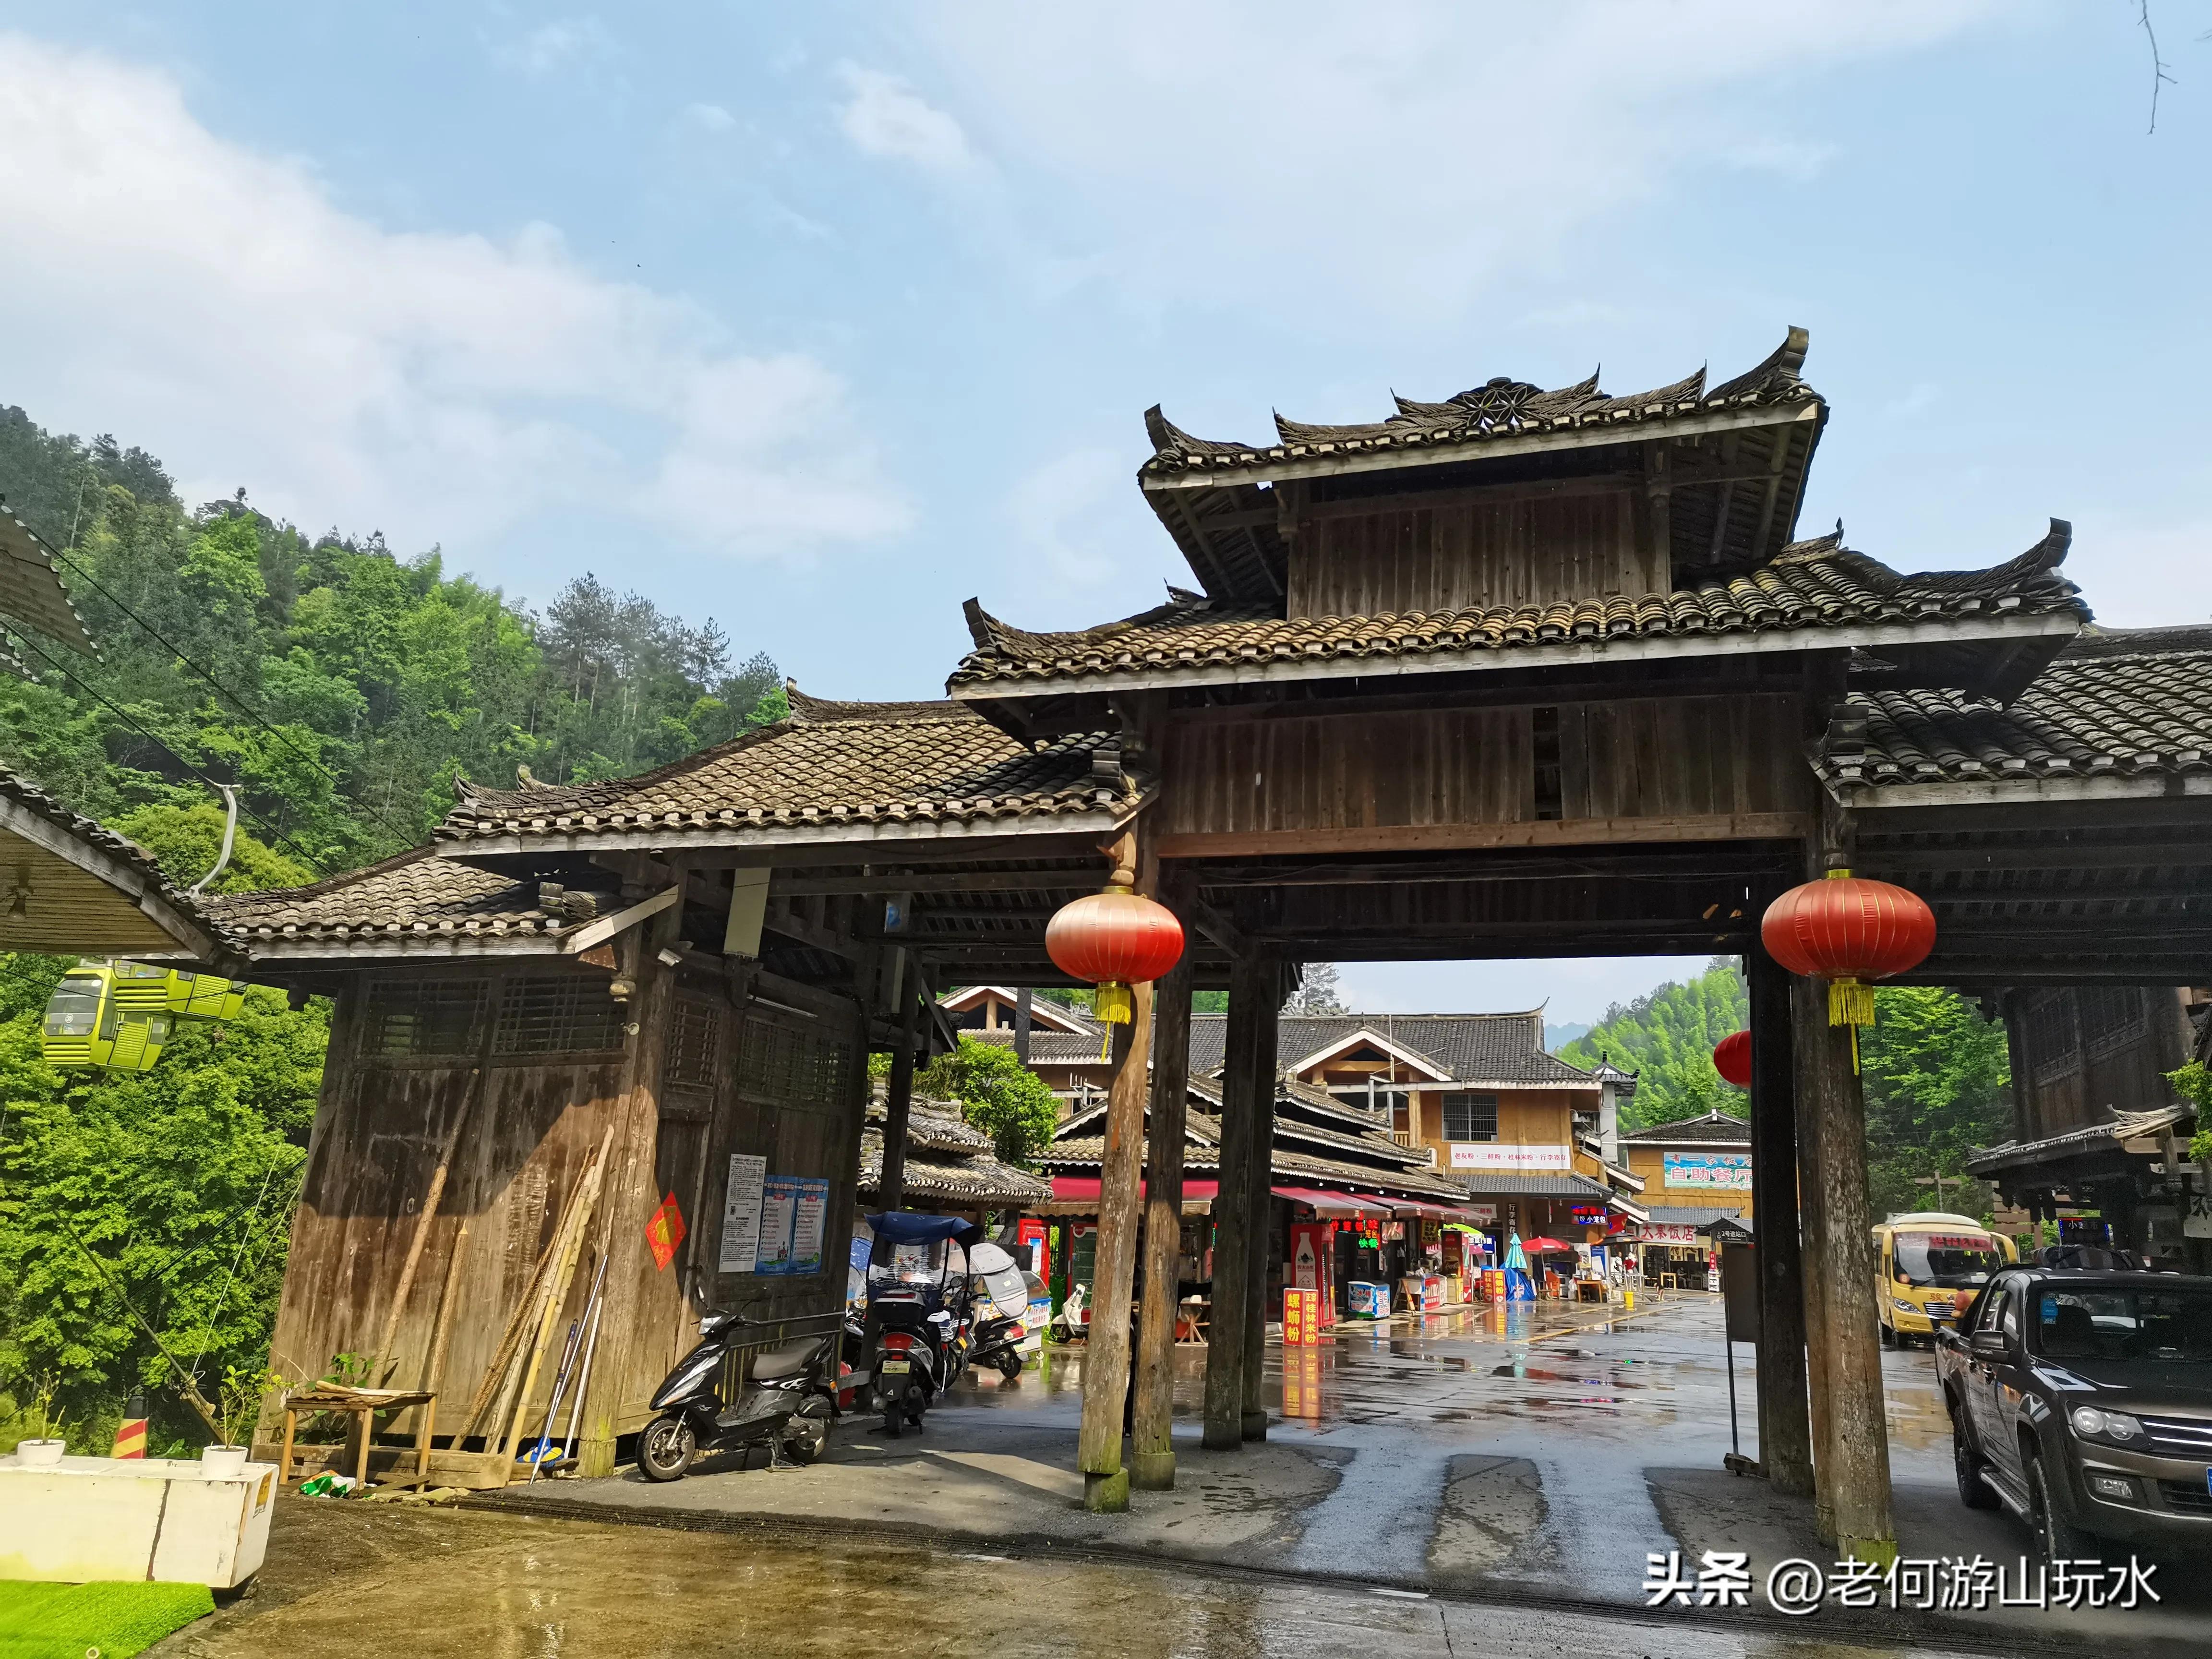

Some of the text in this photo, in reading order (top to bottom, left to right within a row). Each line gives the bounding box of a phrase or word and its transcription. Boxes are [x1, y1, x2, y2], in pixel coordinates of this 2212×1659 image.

[1671, 1167, 1752, 1181] 自助餐厅
[1643, 1224, 1695, 1241] 大寨饭店
[1358, 1238, 1378, 1249] 快餐
[1306, 1293, 1317, 1302] 正宗
[1287, 1294, 1300, 1342] 螺蛳粉
[1305, 1303, 1316, 1343] 桂林米粉
